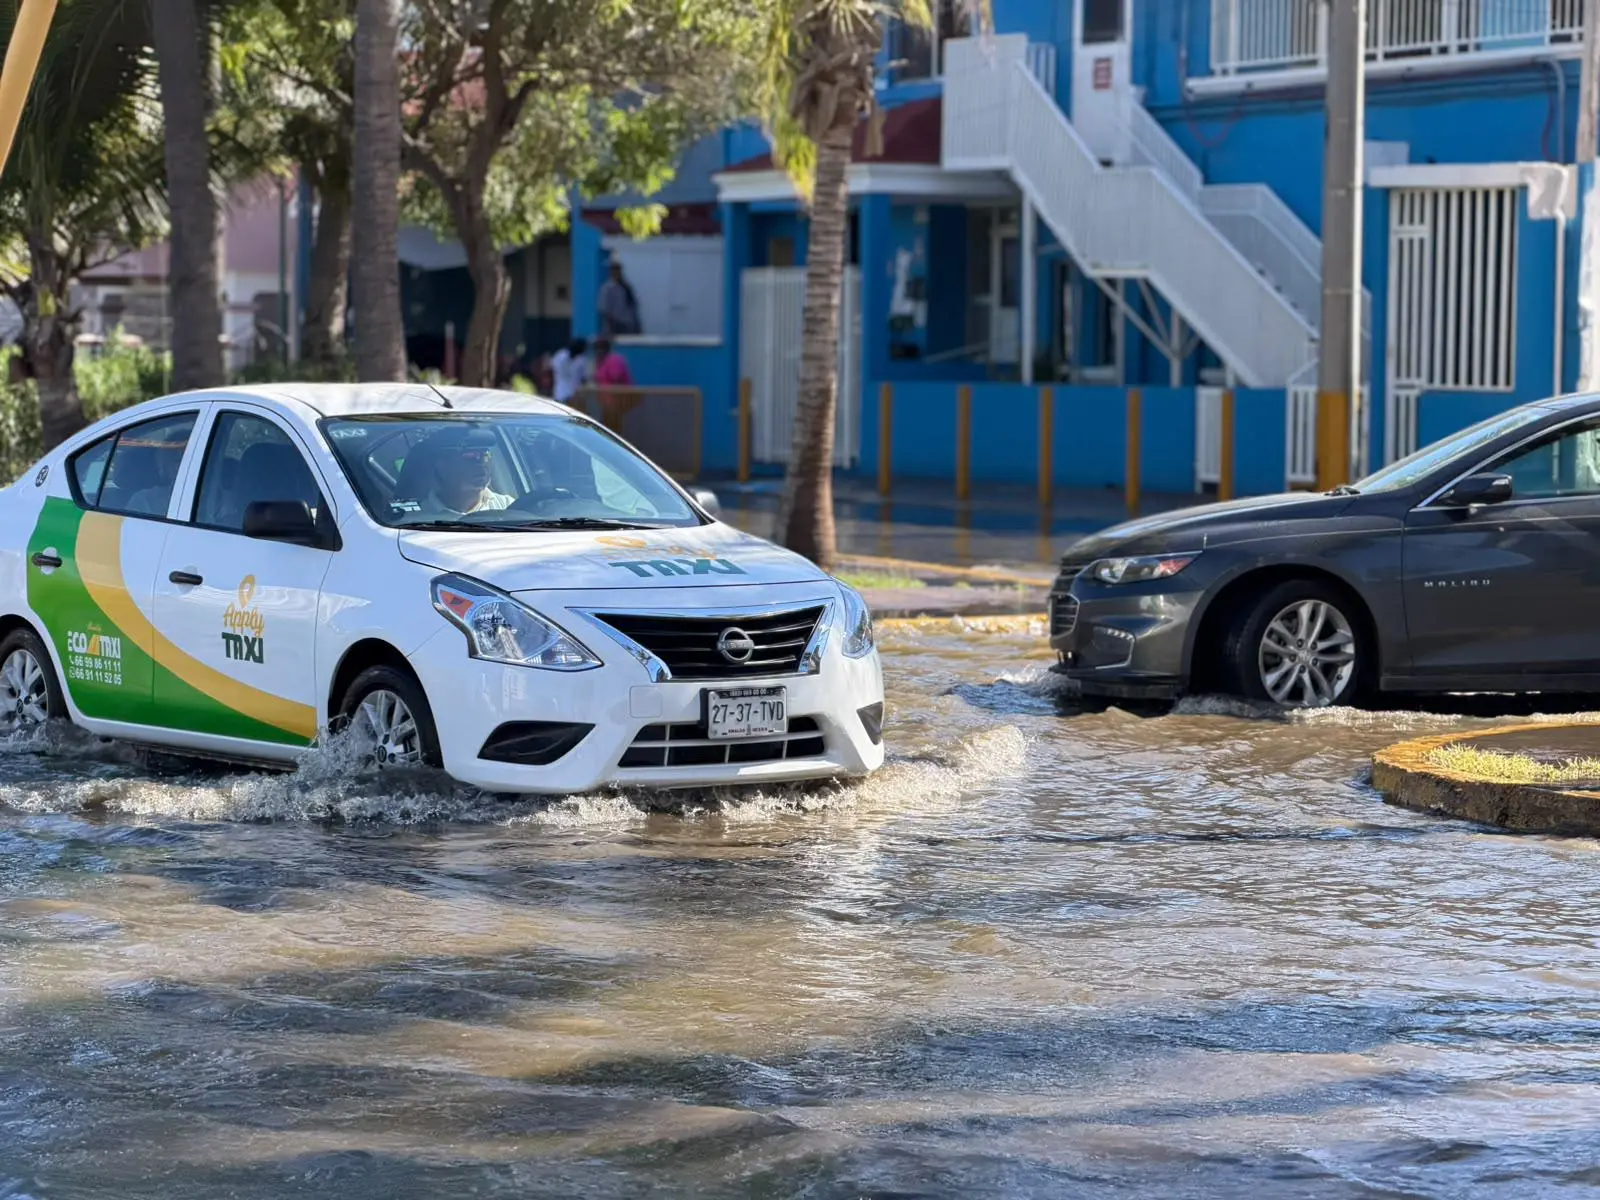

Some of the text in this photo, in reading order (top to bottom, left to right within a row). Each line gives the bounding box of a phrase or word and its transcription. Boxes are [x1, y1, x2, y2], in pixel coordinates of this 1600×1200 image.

[607, 558, 749, 578] TAXI
[221, 631, 265, 664] TAXI
[712, 701, 784, 724] 27-37-TVD
